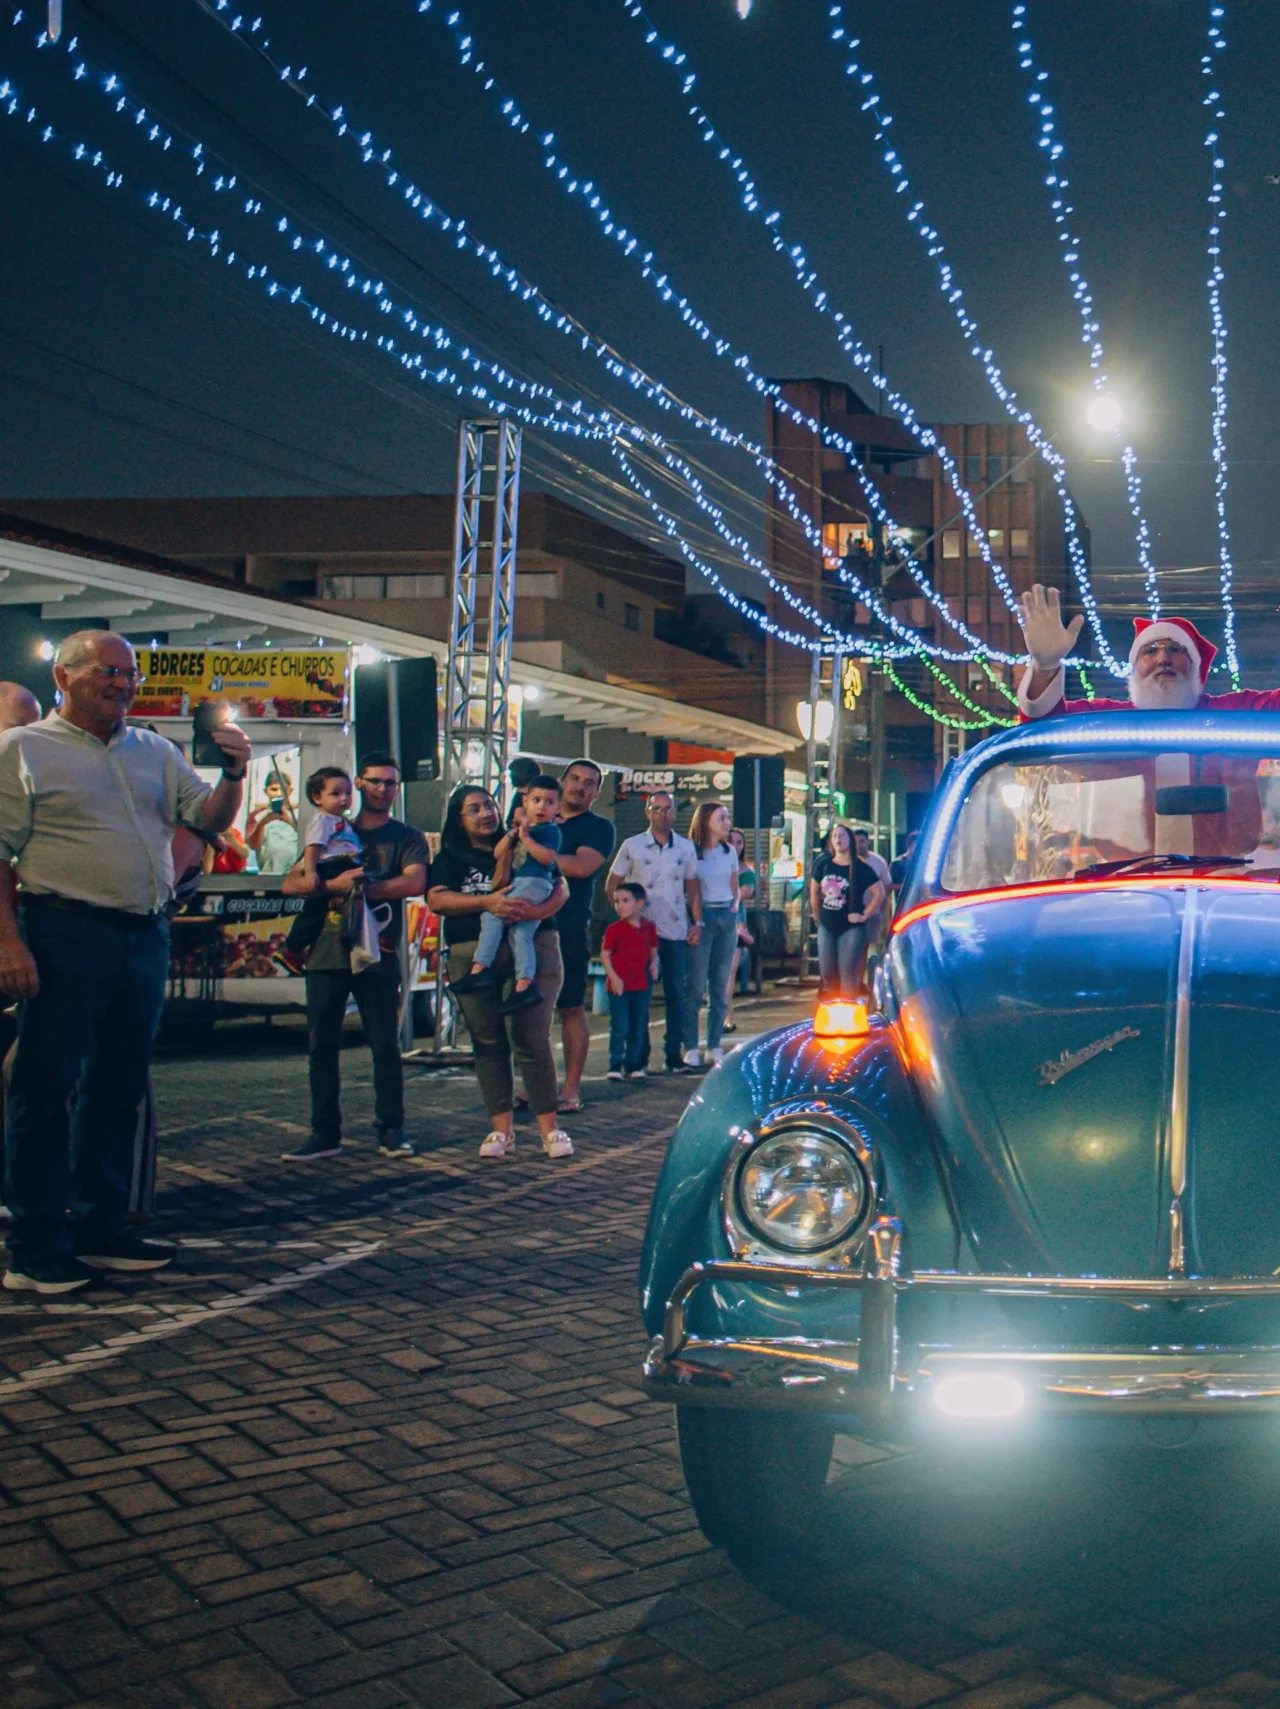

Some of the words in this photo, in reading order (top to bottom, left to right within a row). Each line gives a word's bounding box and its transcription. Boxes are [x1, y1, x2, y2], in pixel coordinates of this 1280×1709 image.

[151, 652, 205, 676] BORGES
[212, 655, 267, 677] COCADAS
[280, 655, 335, 677] CHURROS
[621, 771, 675, 785] DOCES
[227, 898, 282, 913] COCADAS
